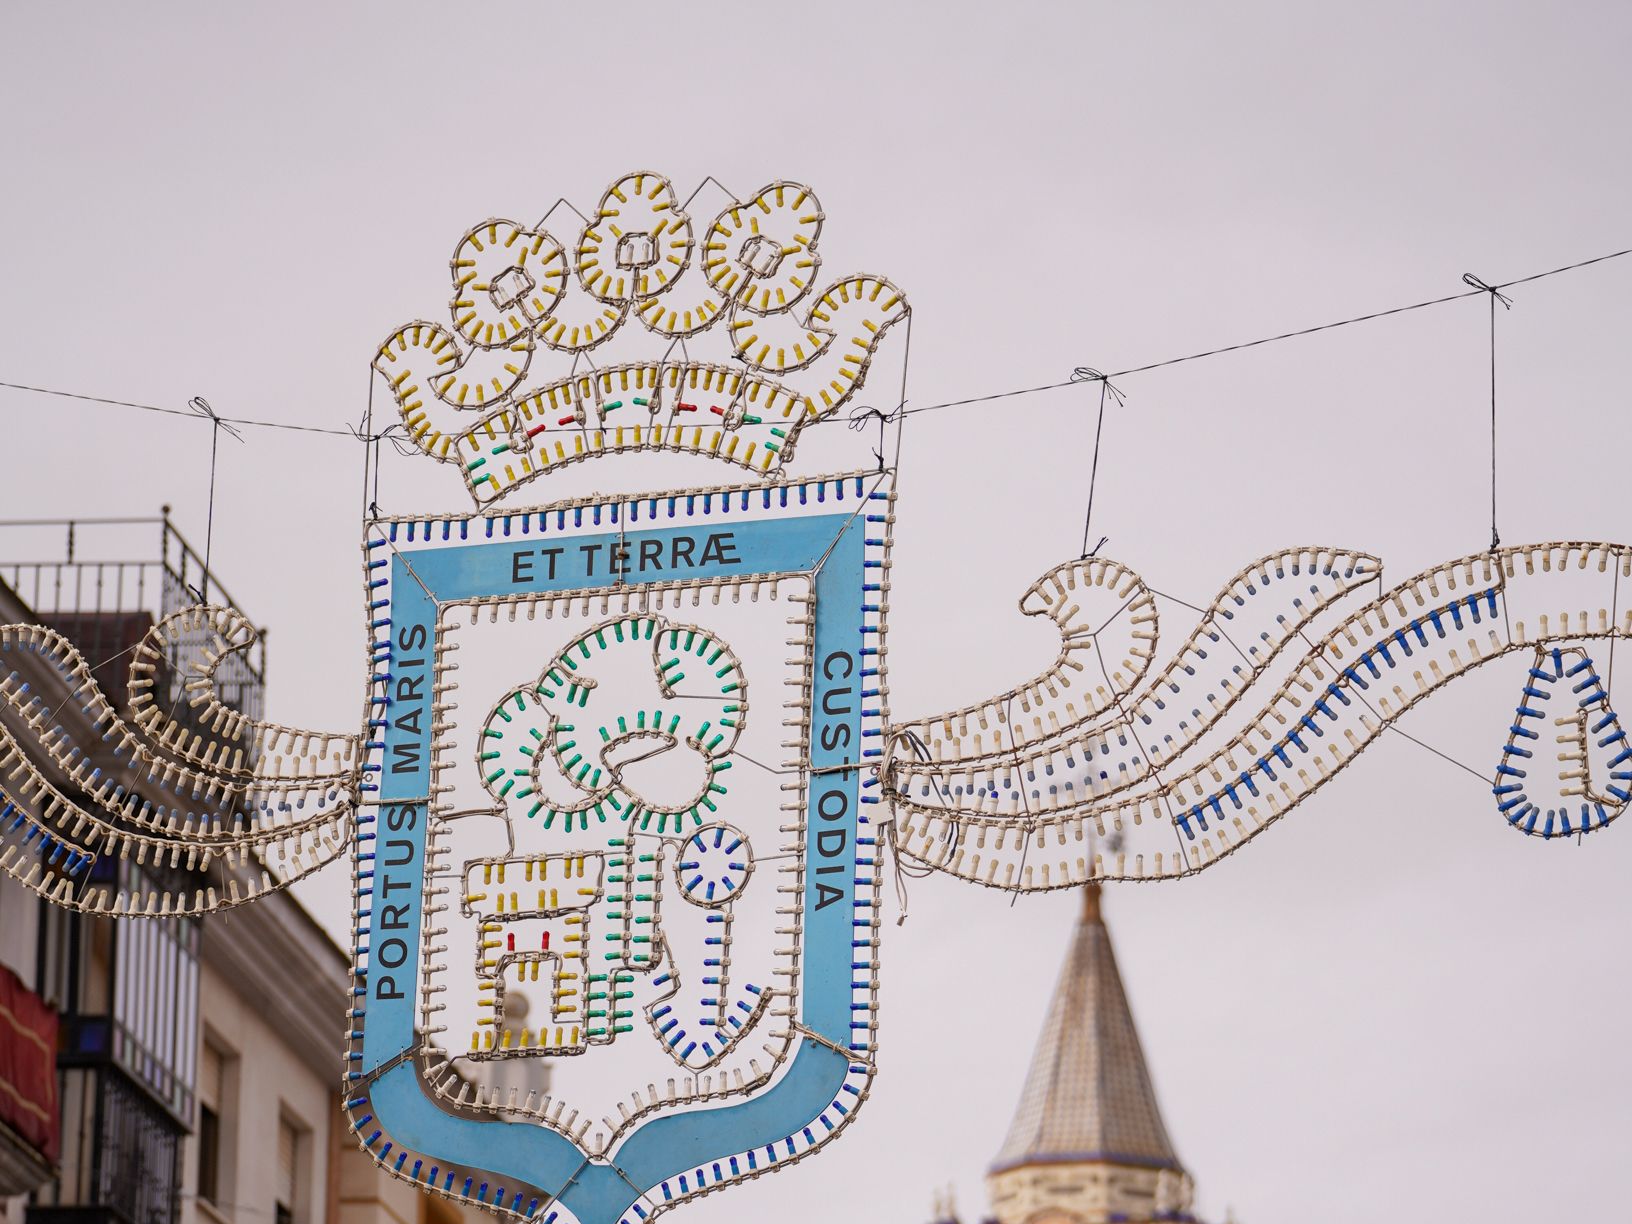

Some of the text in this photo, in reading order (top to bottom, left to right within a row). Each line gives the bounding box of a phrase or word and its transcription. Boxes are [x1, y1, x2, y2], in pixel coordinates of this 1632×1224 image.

[511, 532, 742, 583] ET TERRÆ
[375, 622, 427, 1000] PORTUS MARIS
